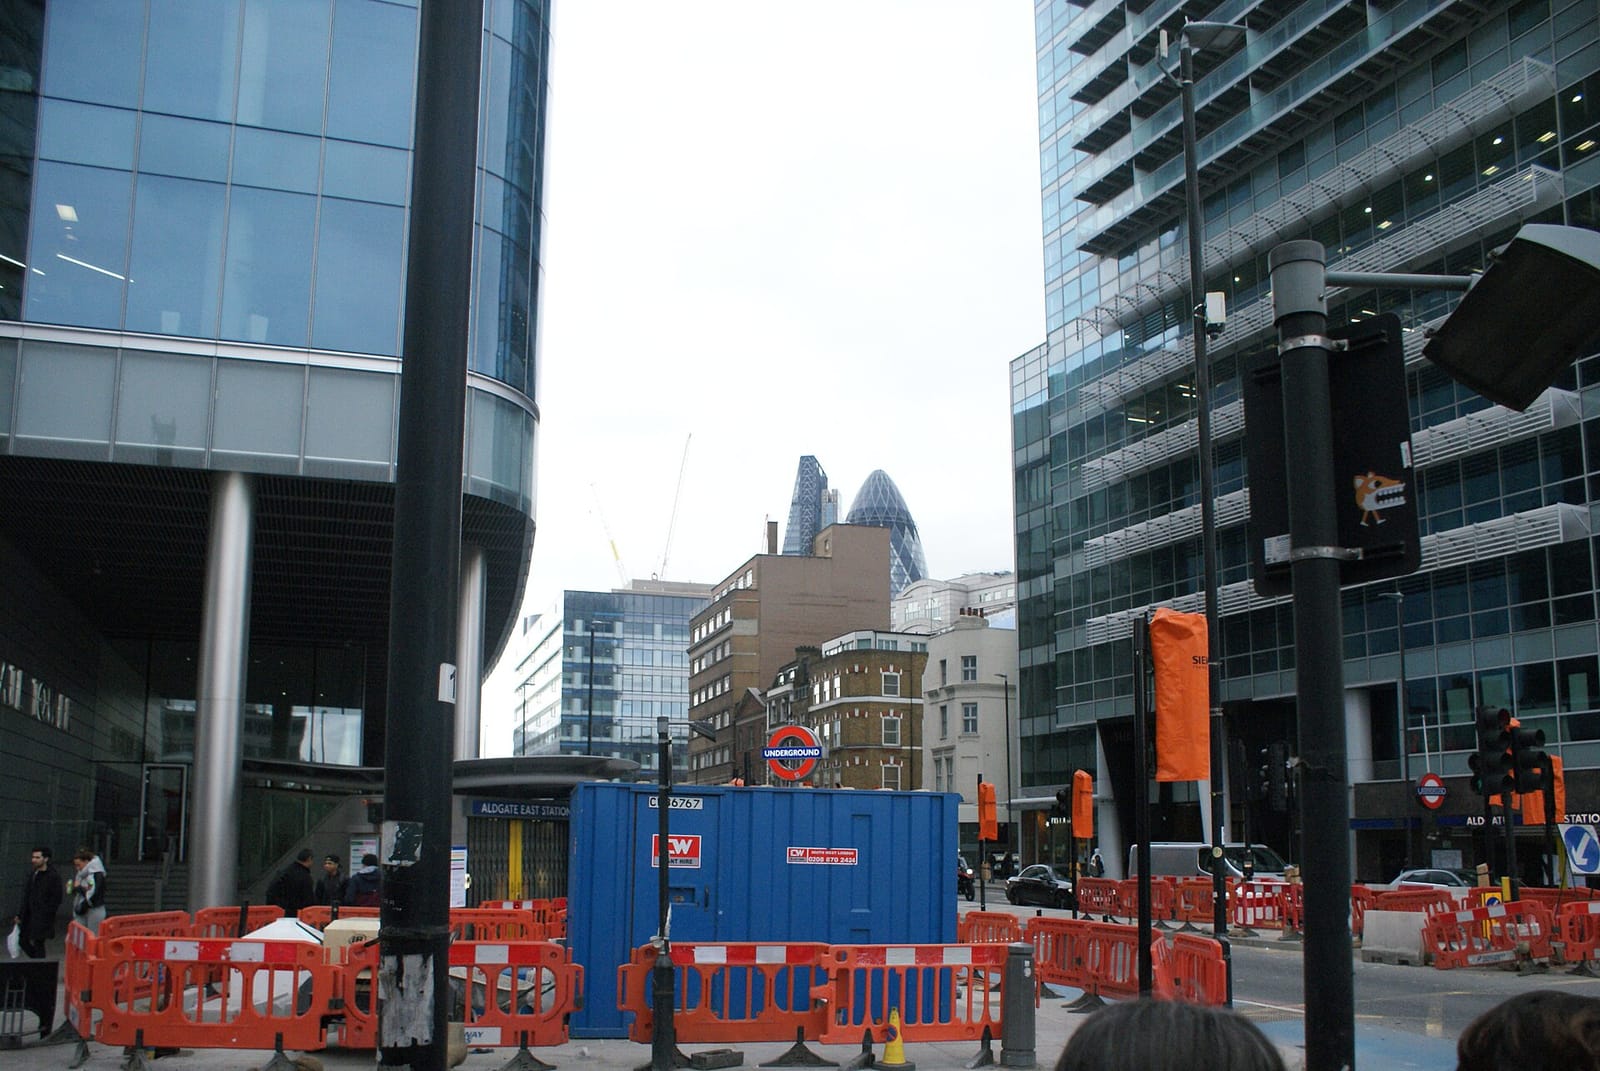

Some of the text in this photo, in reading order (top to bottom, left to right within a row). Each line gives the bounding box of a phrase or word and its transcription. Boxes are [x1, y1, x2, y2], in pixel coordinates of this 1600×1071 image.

[764, 748, 820, 757] UNDERGROUND
[649, 797, 700, 808] C6767
[481, 802, 519, 815] ALDGATE
[520, 804, 540, 815] EAST
[1466, 815, 1505, 826] ALDAT
